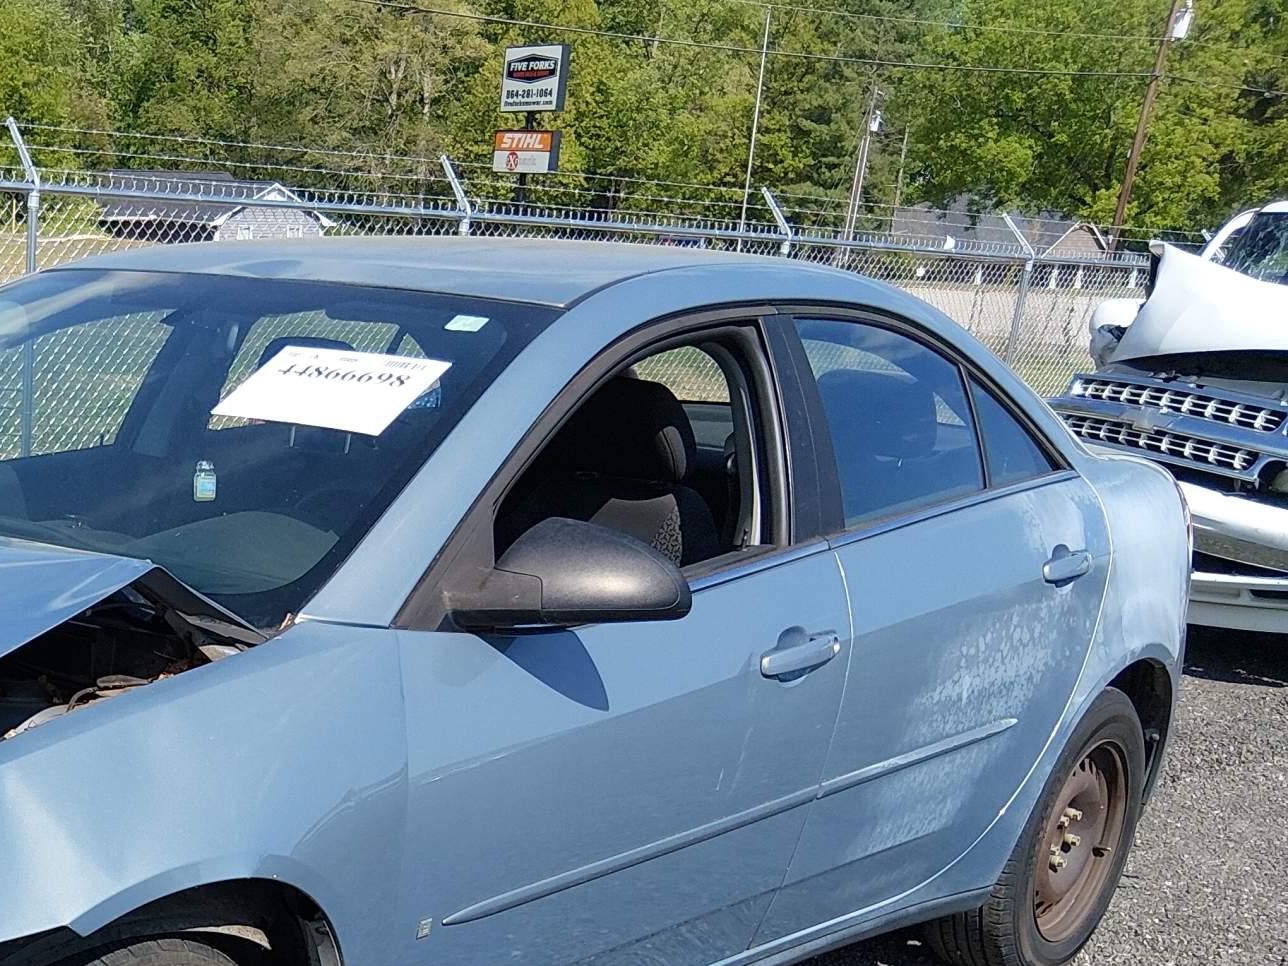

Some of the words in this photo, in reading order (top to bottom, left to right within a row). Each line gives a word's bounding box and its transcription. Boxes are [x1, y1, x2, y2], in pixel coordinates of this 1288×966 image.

[510, 61, 528, 71] FIVE
[528, 60, 556, 71] FORKS
[500, 133, 545, 149] STIHL
[278, 363, 411, 387] 44866698
